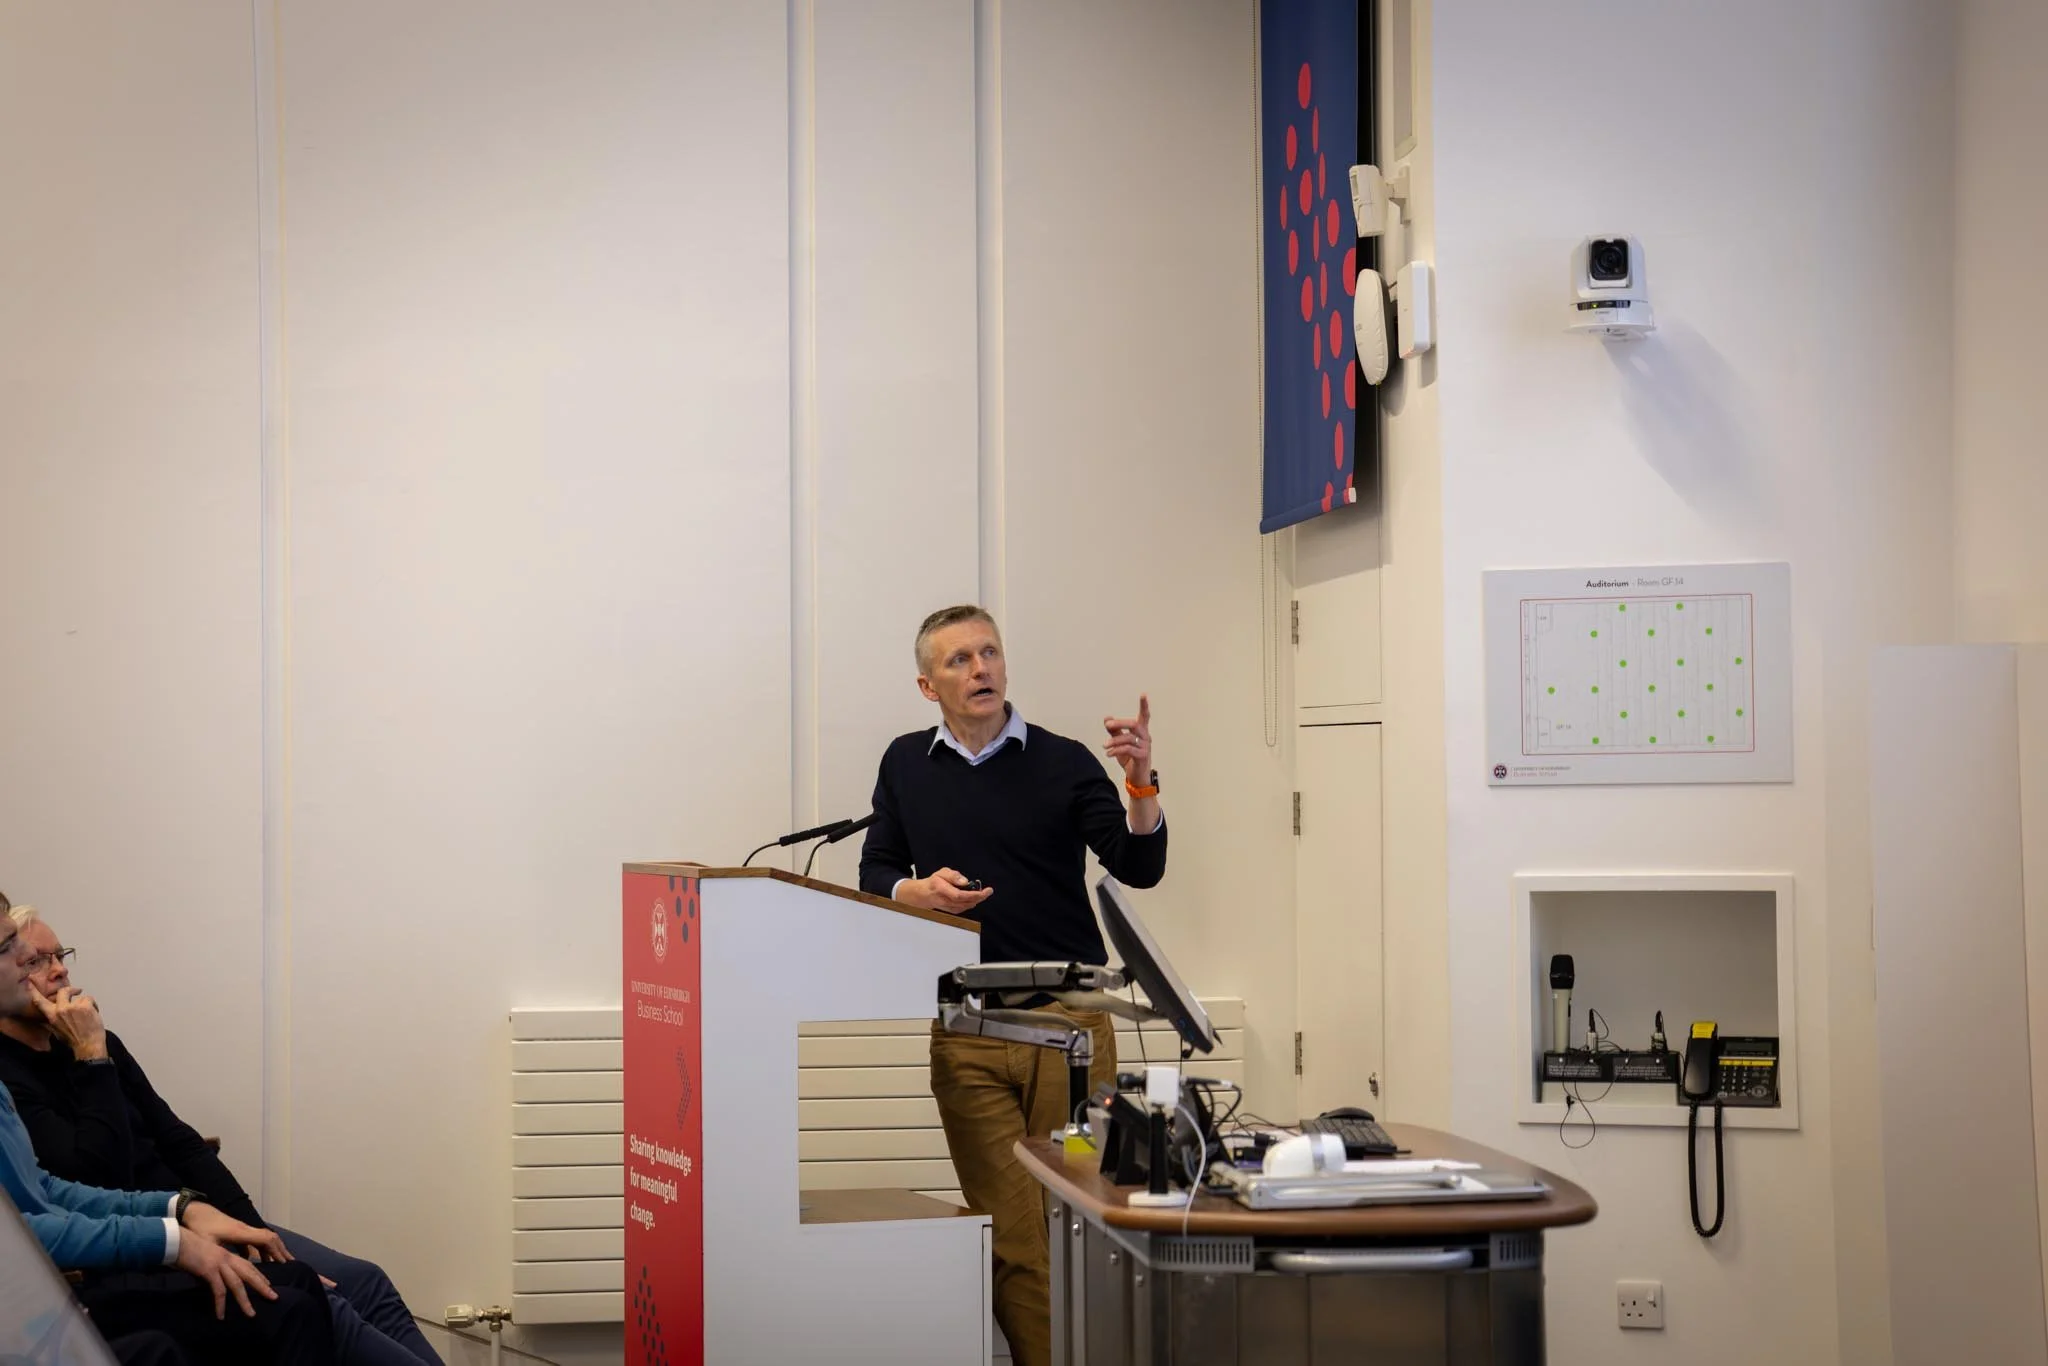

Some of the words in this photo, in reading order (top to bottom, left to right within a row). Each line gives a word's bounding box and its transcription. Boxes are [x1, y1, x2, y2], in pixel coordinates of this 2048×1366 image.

[1586, 579, 1629, 588] Auditorium
[637, 999, 662, 1022] Business
[663, 1005, 684, 1026] School
[630, 1134, 655, 1165] Sharing
[655, 1141, 692, 1176] knowledge
[630, 1166, 640, 1188] for
[640, 1175, 678, 1204] meaningful
[630, 1200, 656, 1231] change.
